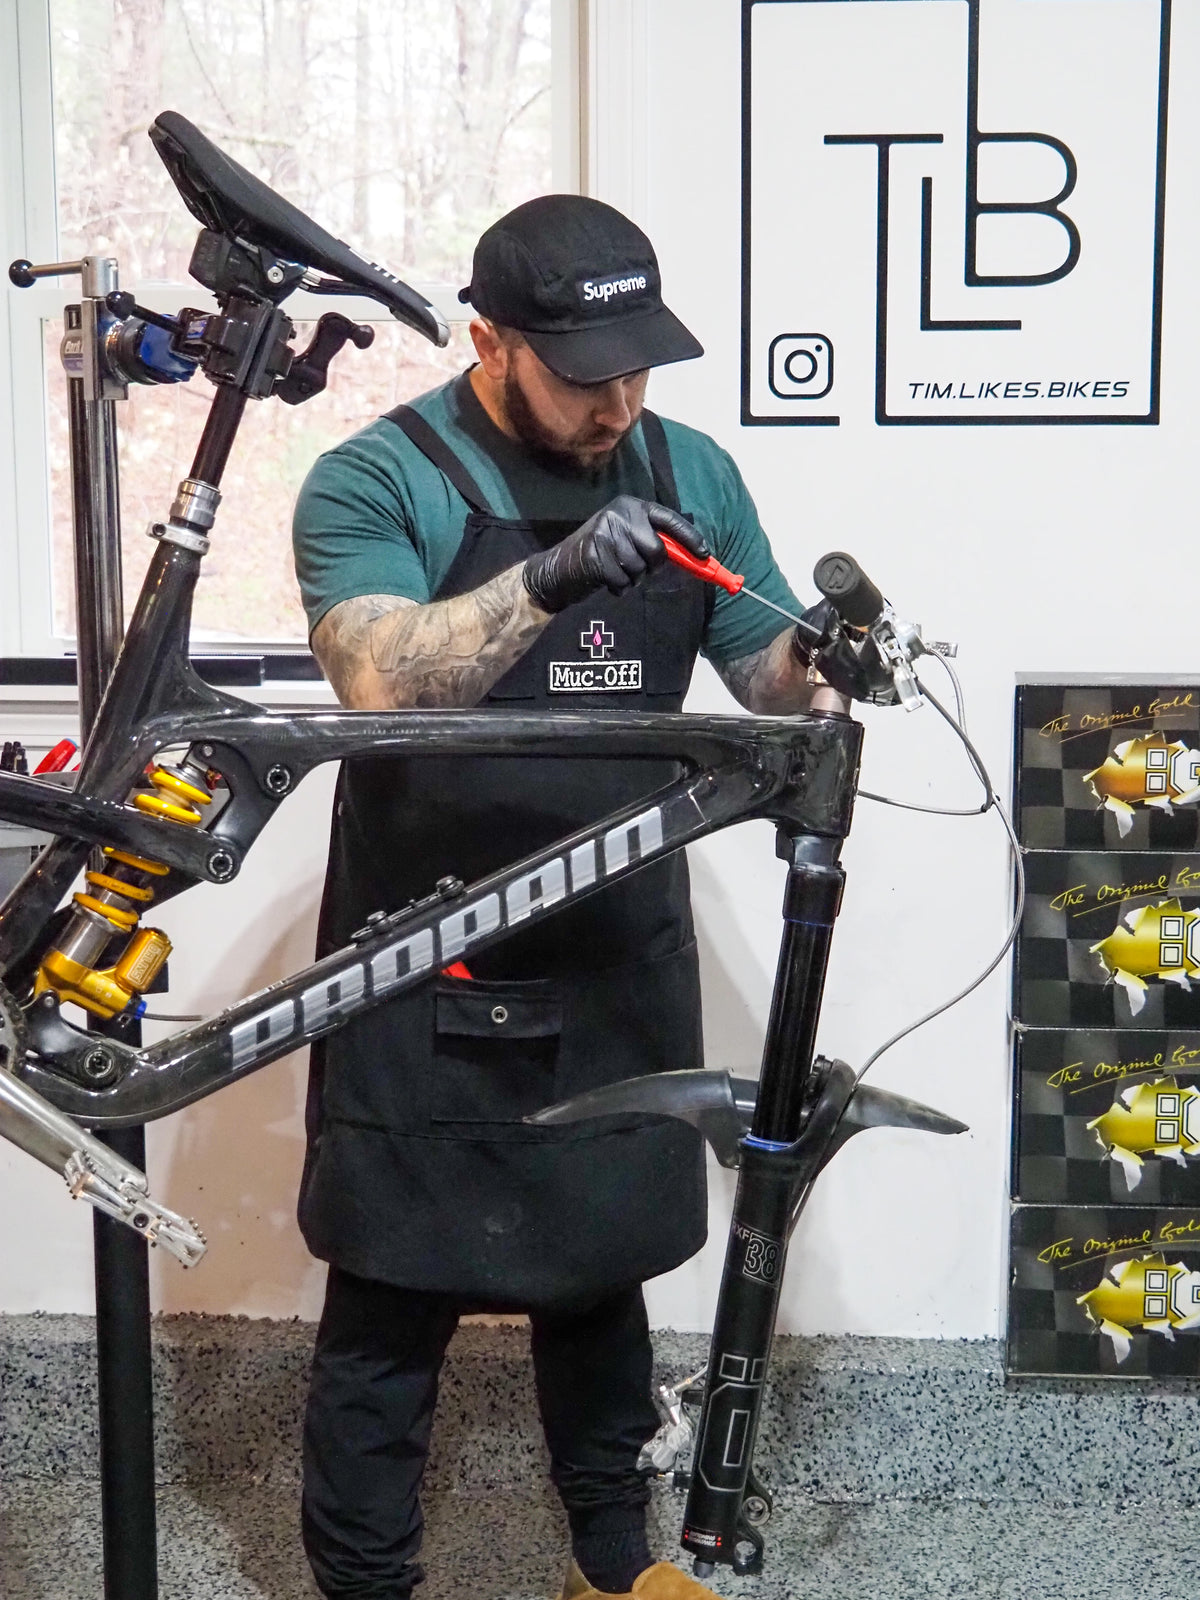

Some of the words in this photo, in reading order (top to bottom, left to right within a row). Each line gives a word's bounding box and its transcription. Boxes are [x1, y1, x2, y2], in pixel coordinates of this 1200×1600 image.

[582, 275, 647, 302] Supreme
[908, 381, 1130, 399] TIM.LIKES.BIKES
[553, 663, 639, 688] Muc-Off
[1038, 715, 1070, 738] The
[1049, 884, 1087, 911] The
[230, 805, 664, 1070] PROPAIN
[1046, 1061, 1084, 1089] The
[745, 1238, 780, 1279] 38
[1037, 1238, 1073, 1264] The
